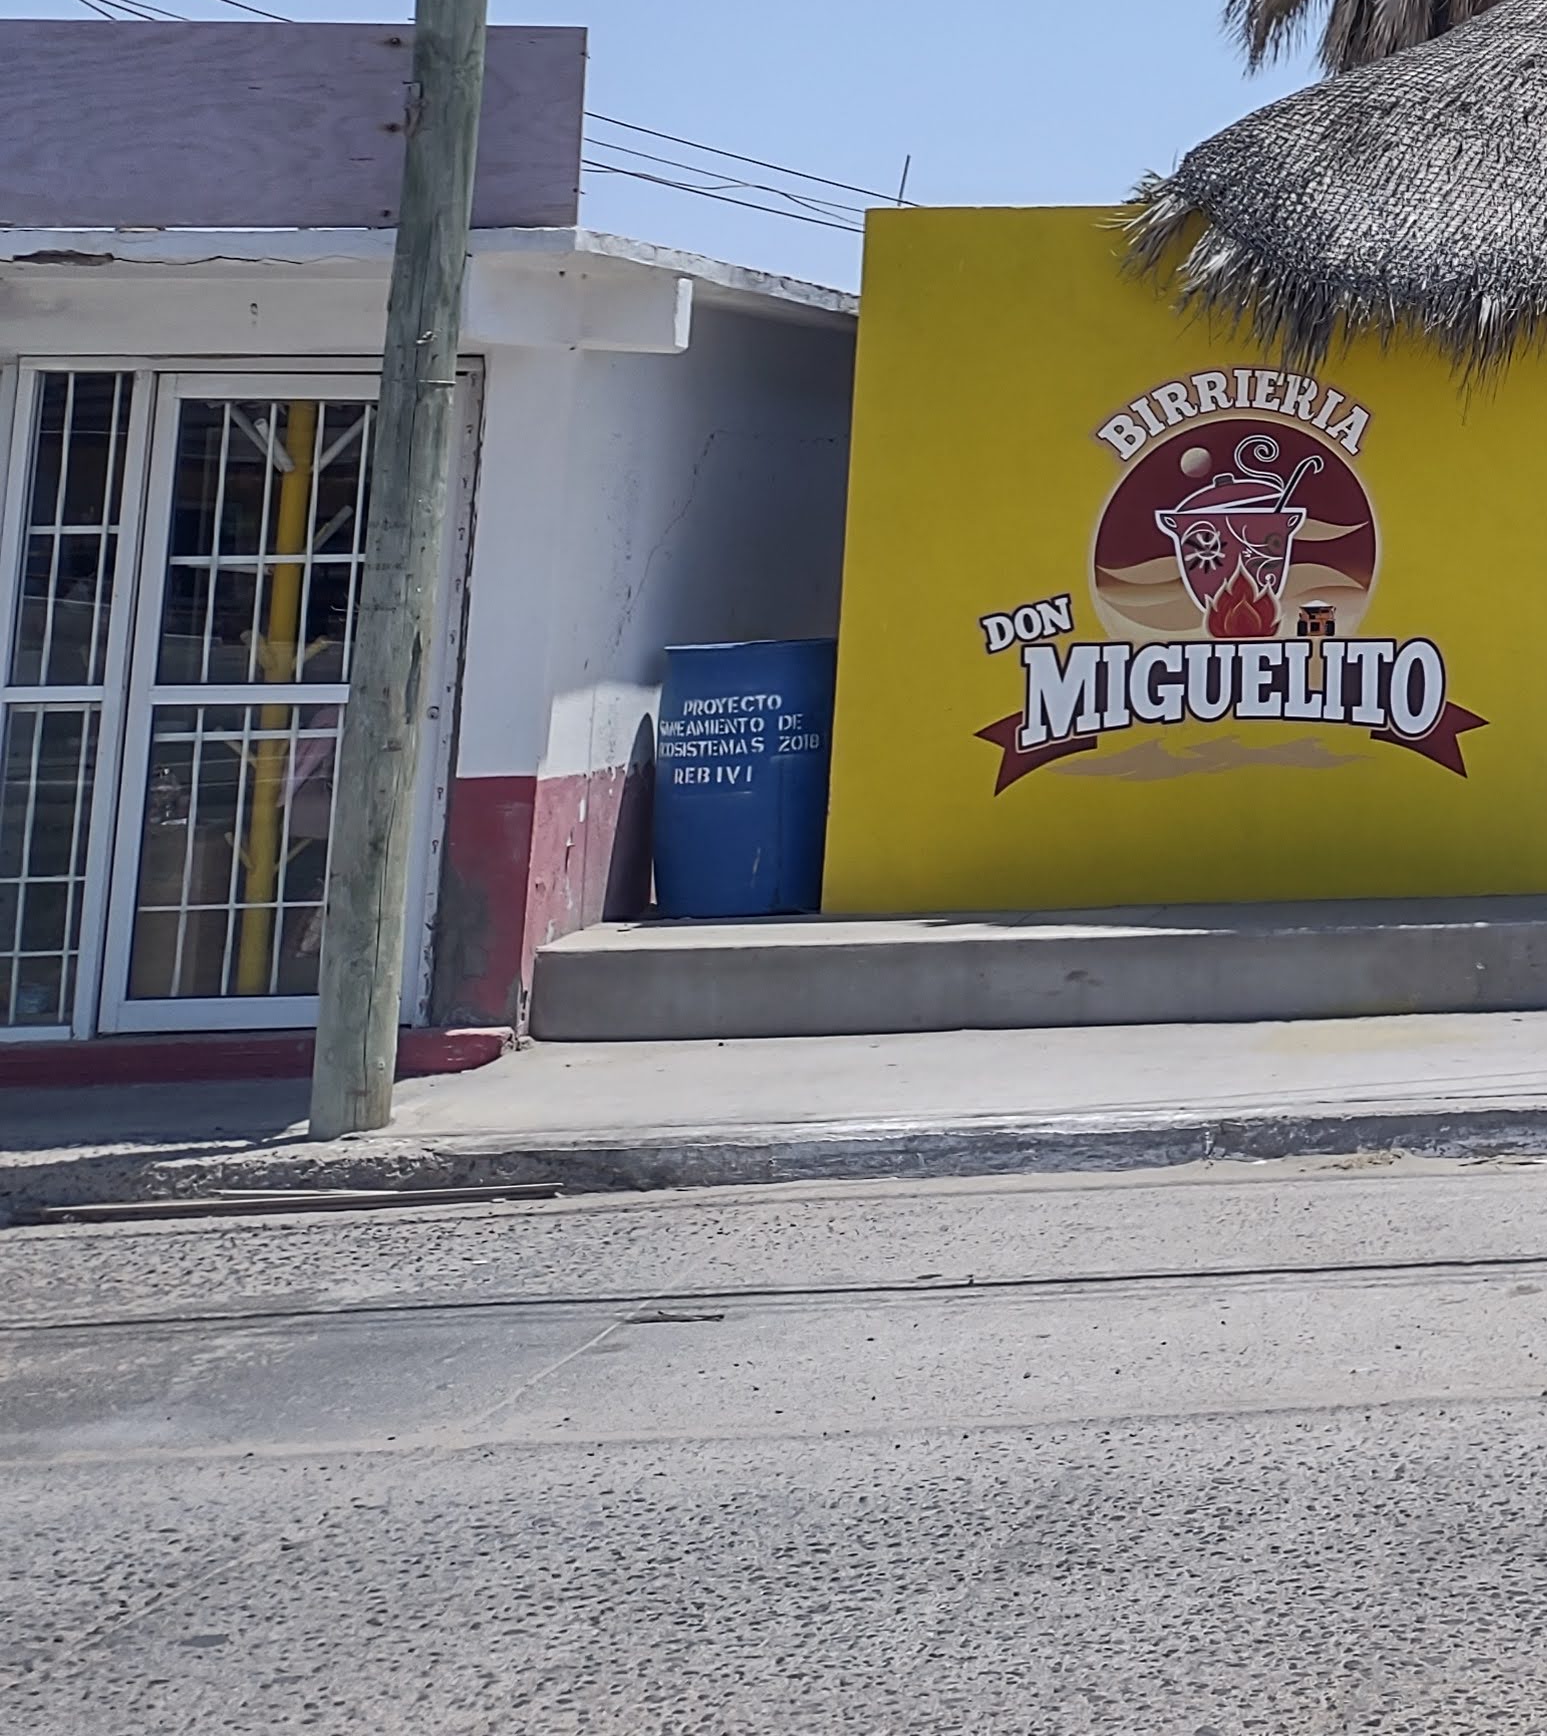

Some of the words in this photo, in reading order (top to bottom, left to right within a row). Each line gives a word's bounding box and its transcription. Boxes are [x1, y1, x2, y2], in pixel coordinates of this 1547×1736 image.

[1095, 367, 1373, 461] BIRRIERIA
[979, 595, 1074, 654] DON
[683, 694, 783, 717] PROYECTO
[778, 714, 803, 731] DE
[1017, 637, 1447, 750] MIGUELITO
